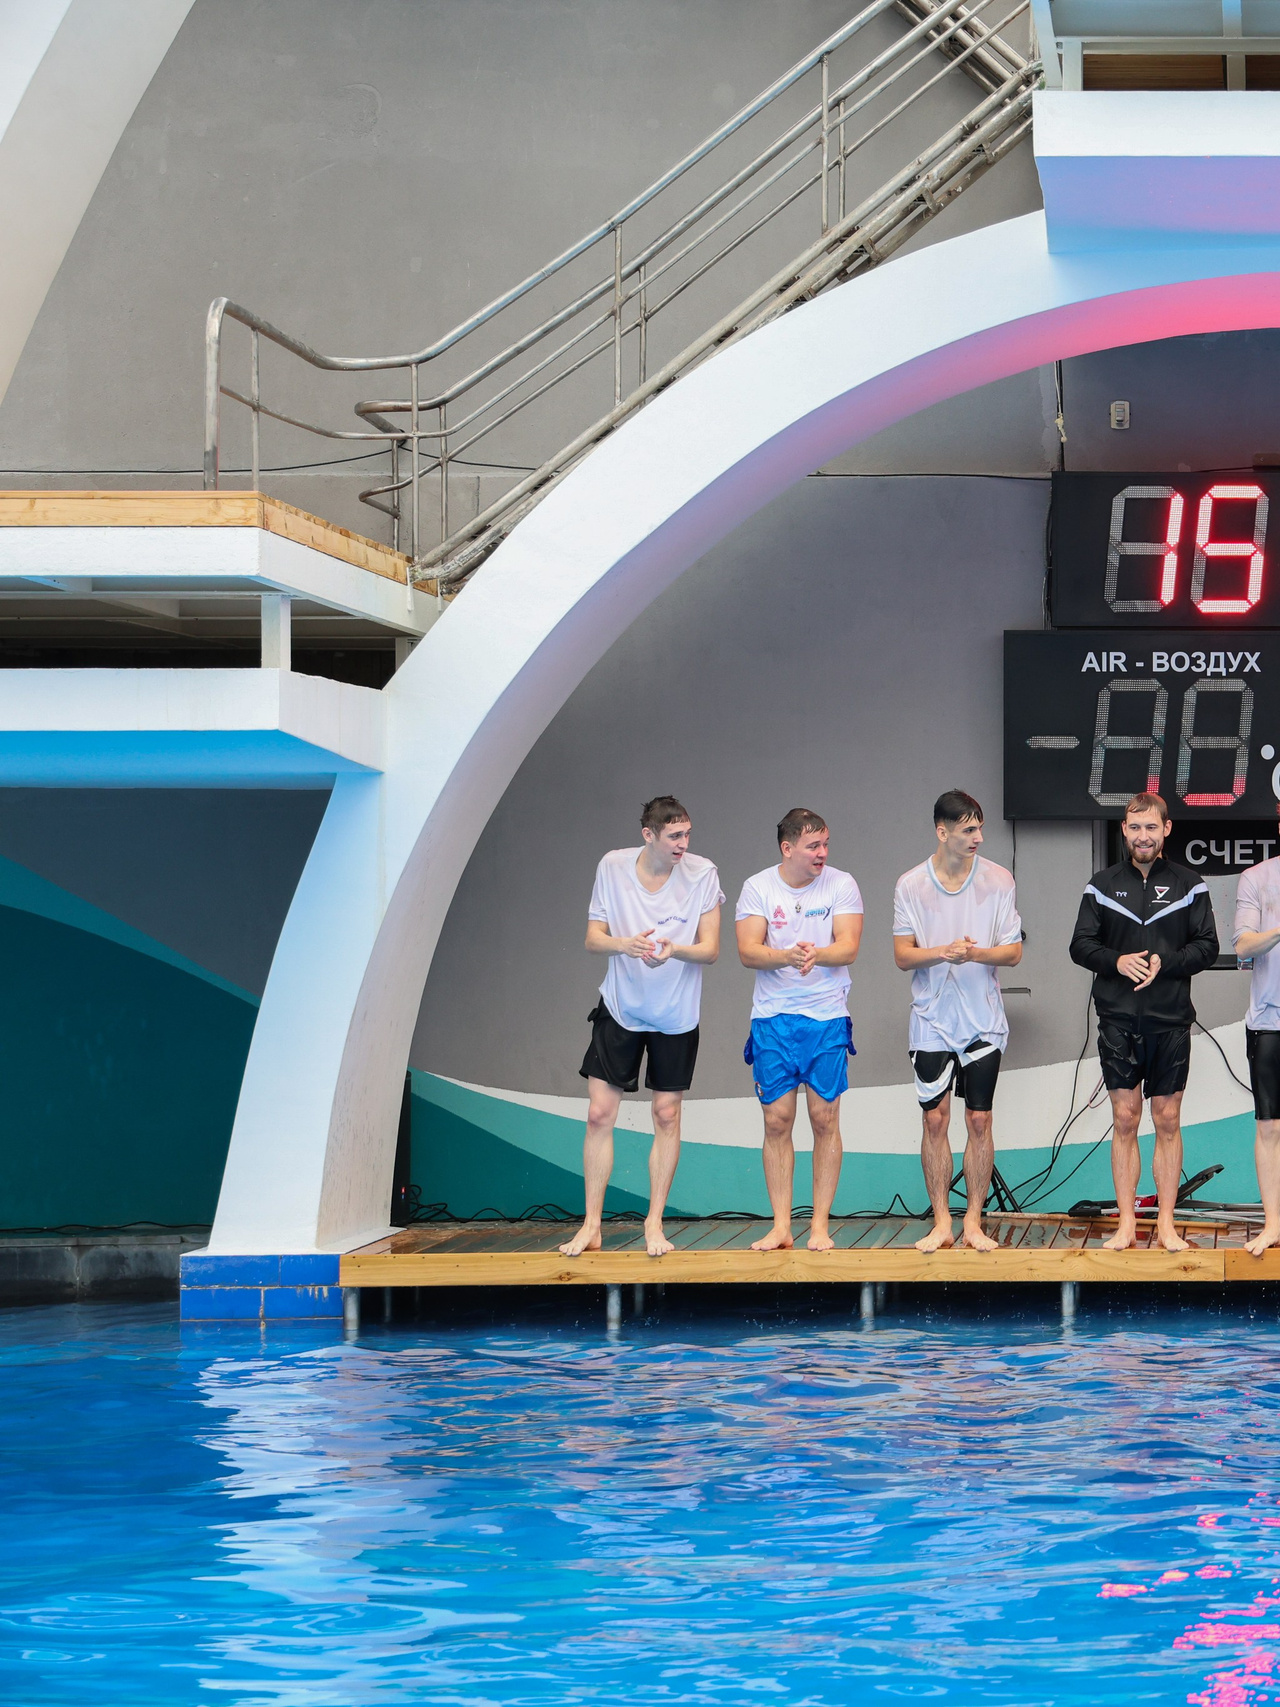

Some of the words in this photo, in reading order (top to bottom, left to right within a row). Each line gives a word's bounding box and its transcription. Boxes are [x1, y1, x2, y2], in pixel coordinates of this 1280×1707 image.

[1081, 651, 1127, 673] AIR
[1151, 651, 1261, 676] ВОЗДУХ
[1185, 839, 1276, 865] СЧЕТ
